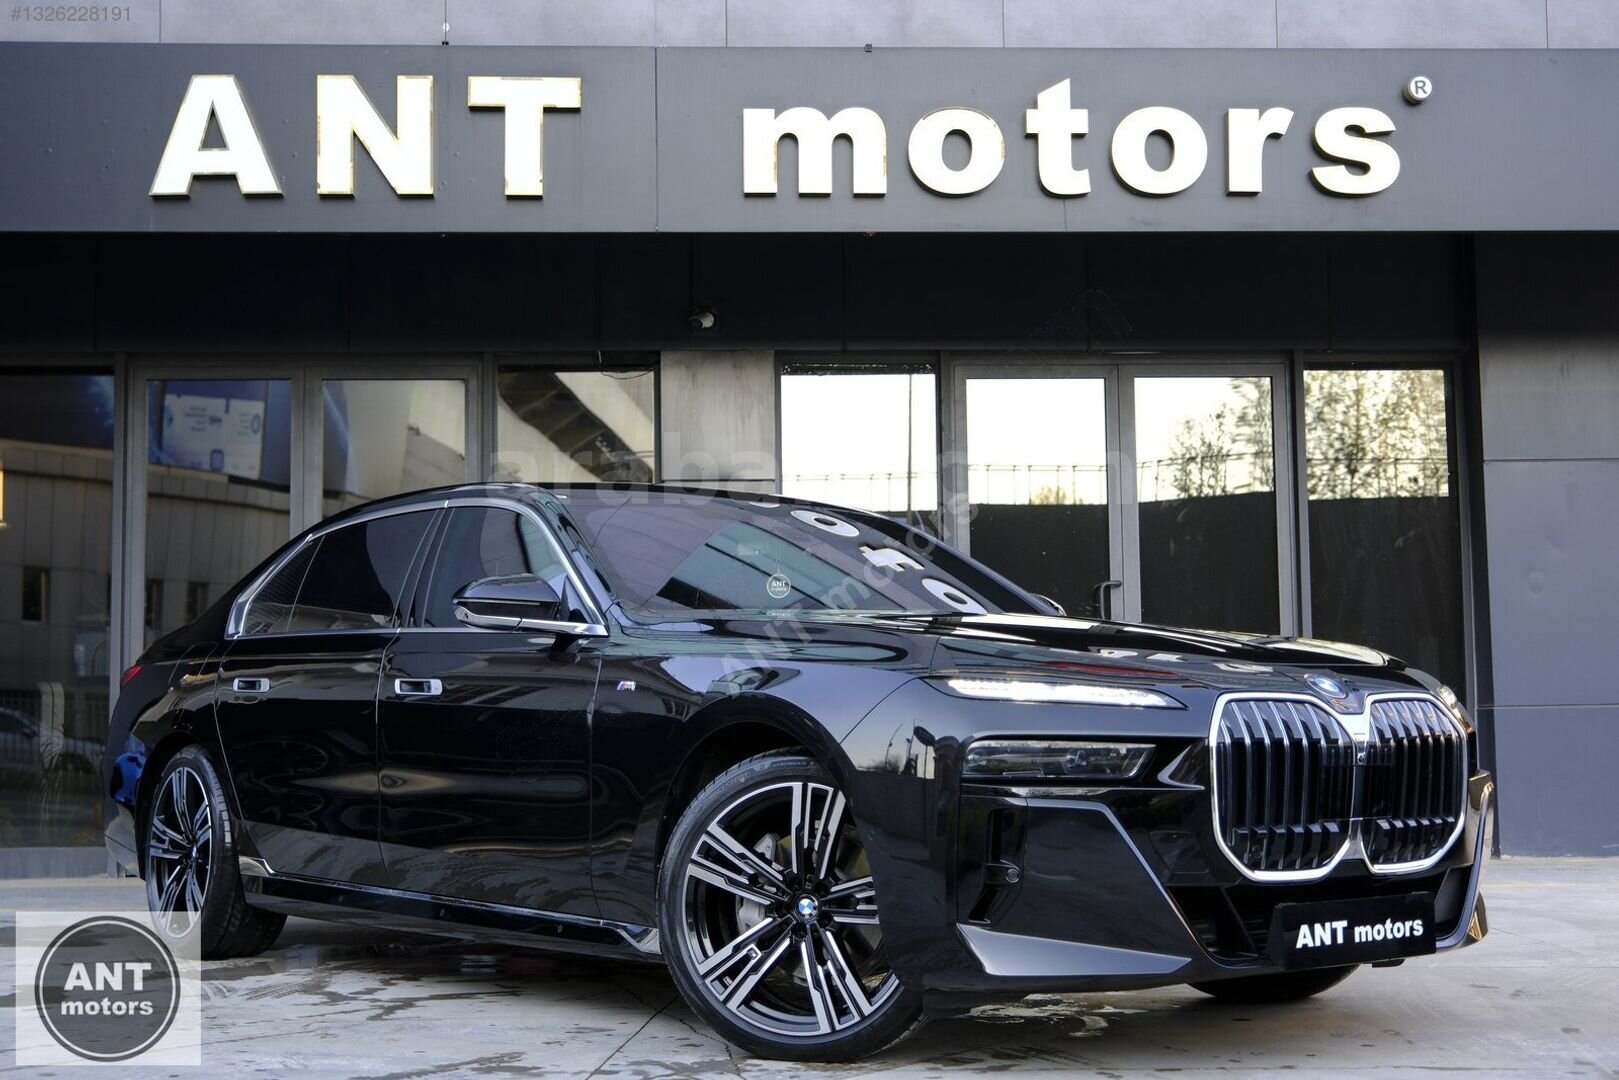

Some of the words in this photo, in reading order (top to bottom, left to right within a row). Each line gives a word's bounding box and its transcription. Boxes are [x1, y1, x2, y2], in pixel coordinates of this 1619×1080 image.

[150, 74, 583, 197] ANT
[742, 78, 1402, 196] motors
[1295, 919, 1349, 949] ANT
[1354, 917, 1425, 943] motors
